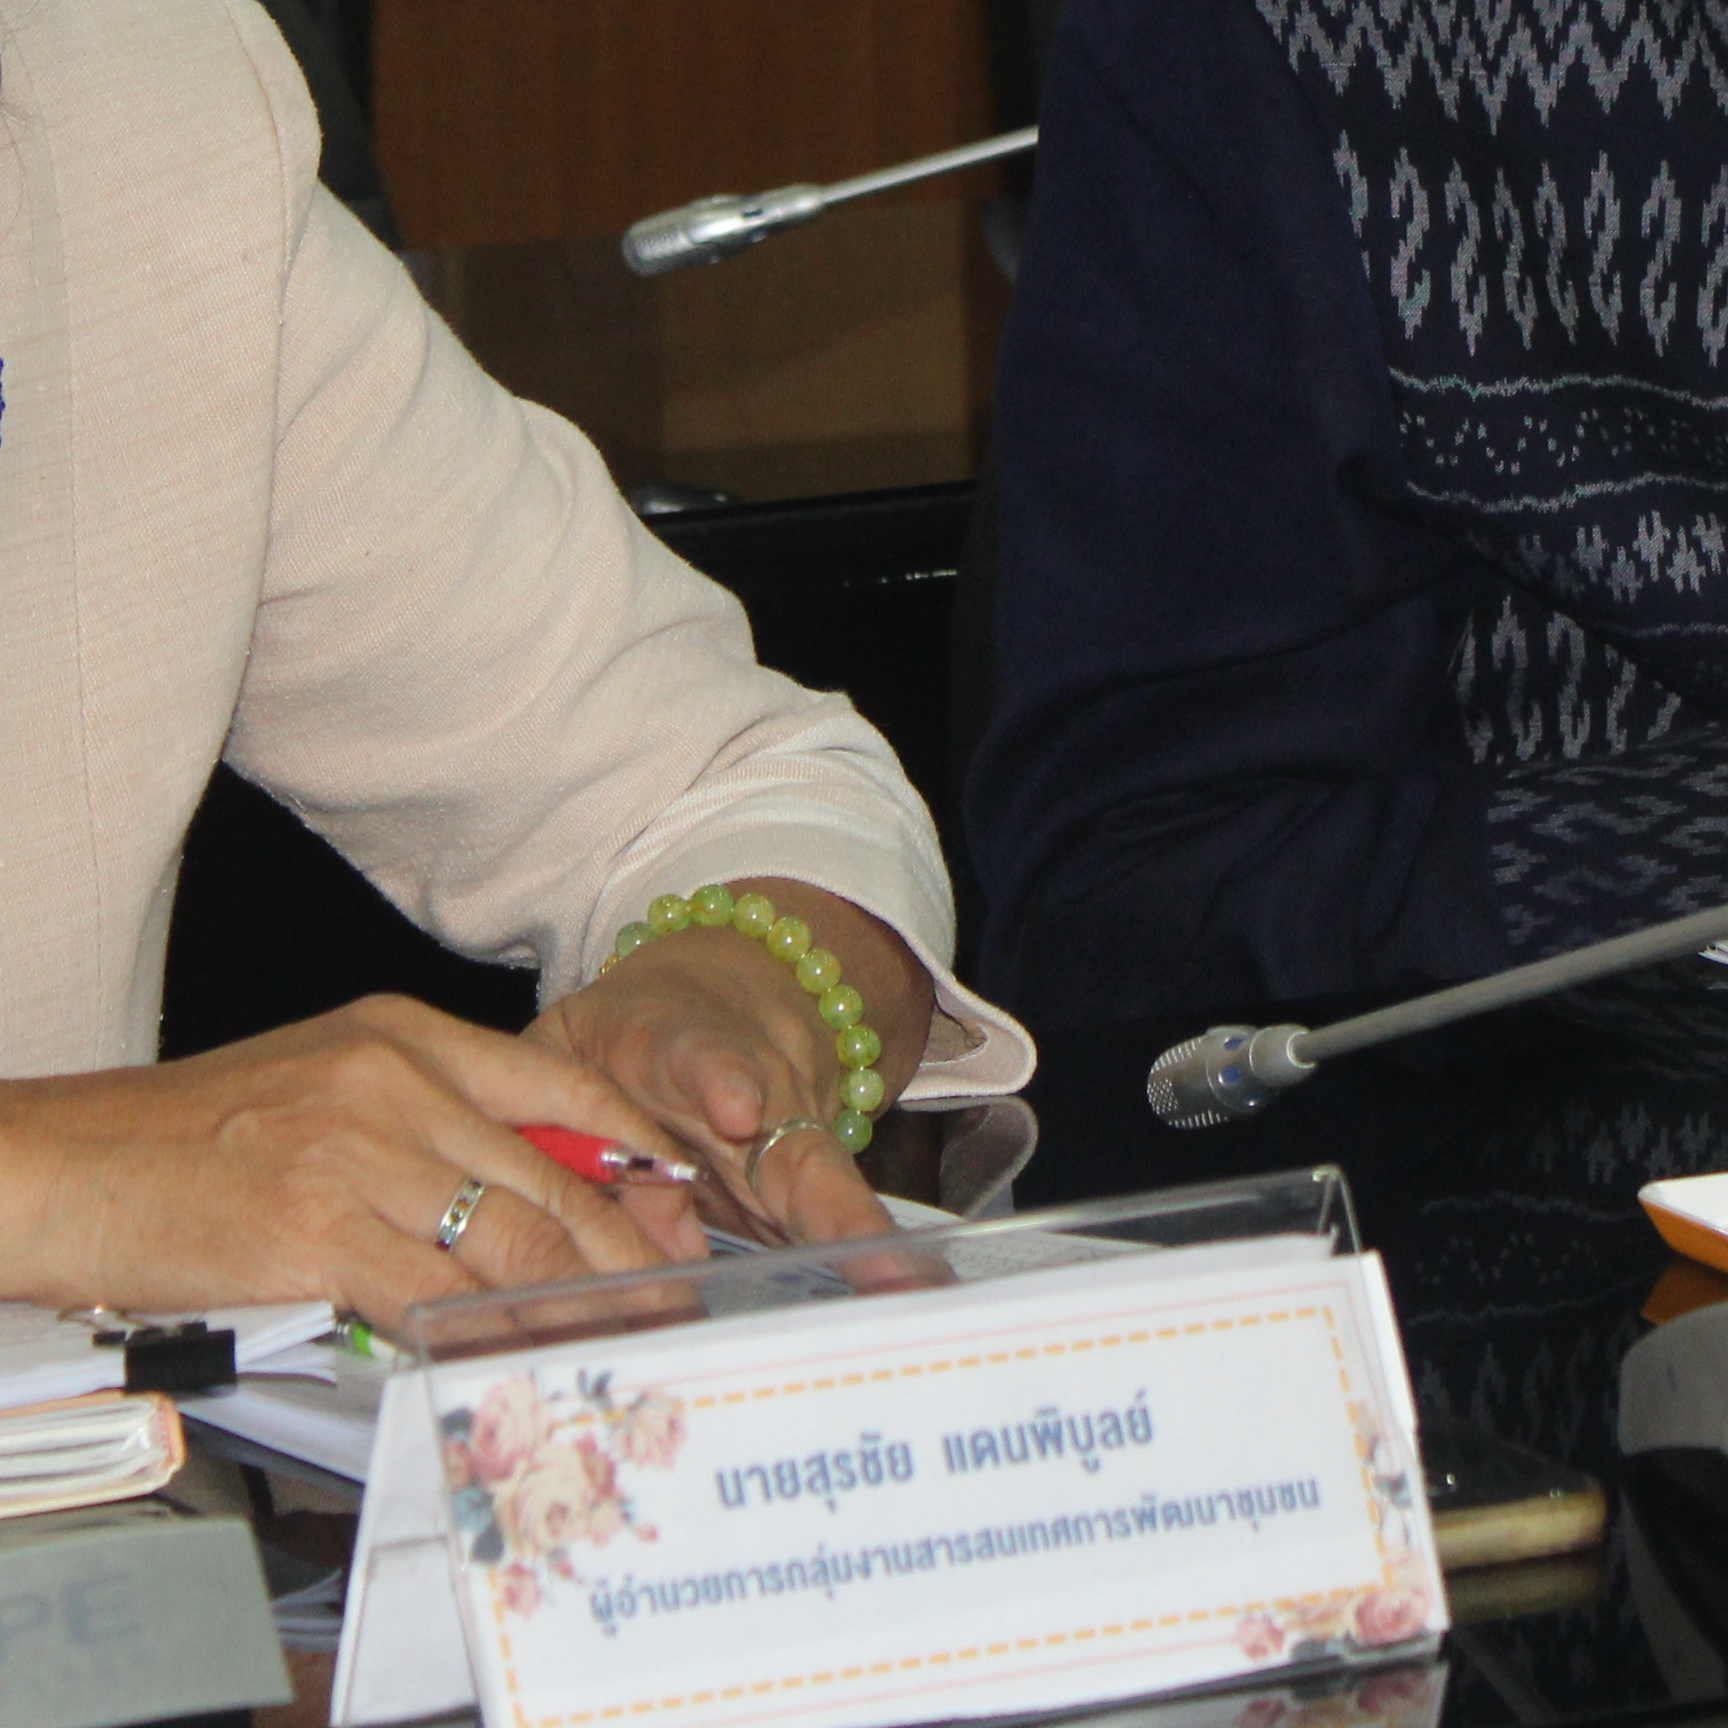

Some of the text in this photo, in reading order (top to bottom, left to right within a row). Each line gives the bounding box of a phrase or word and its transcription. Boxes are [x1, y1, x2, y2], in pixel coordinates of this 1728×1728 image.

[715, 1387, 1155, 1515] นายสุรชัย แคนพิบูลย์
